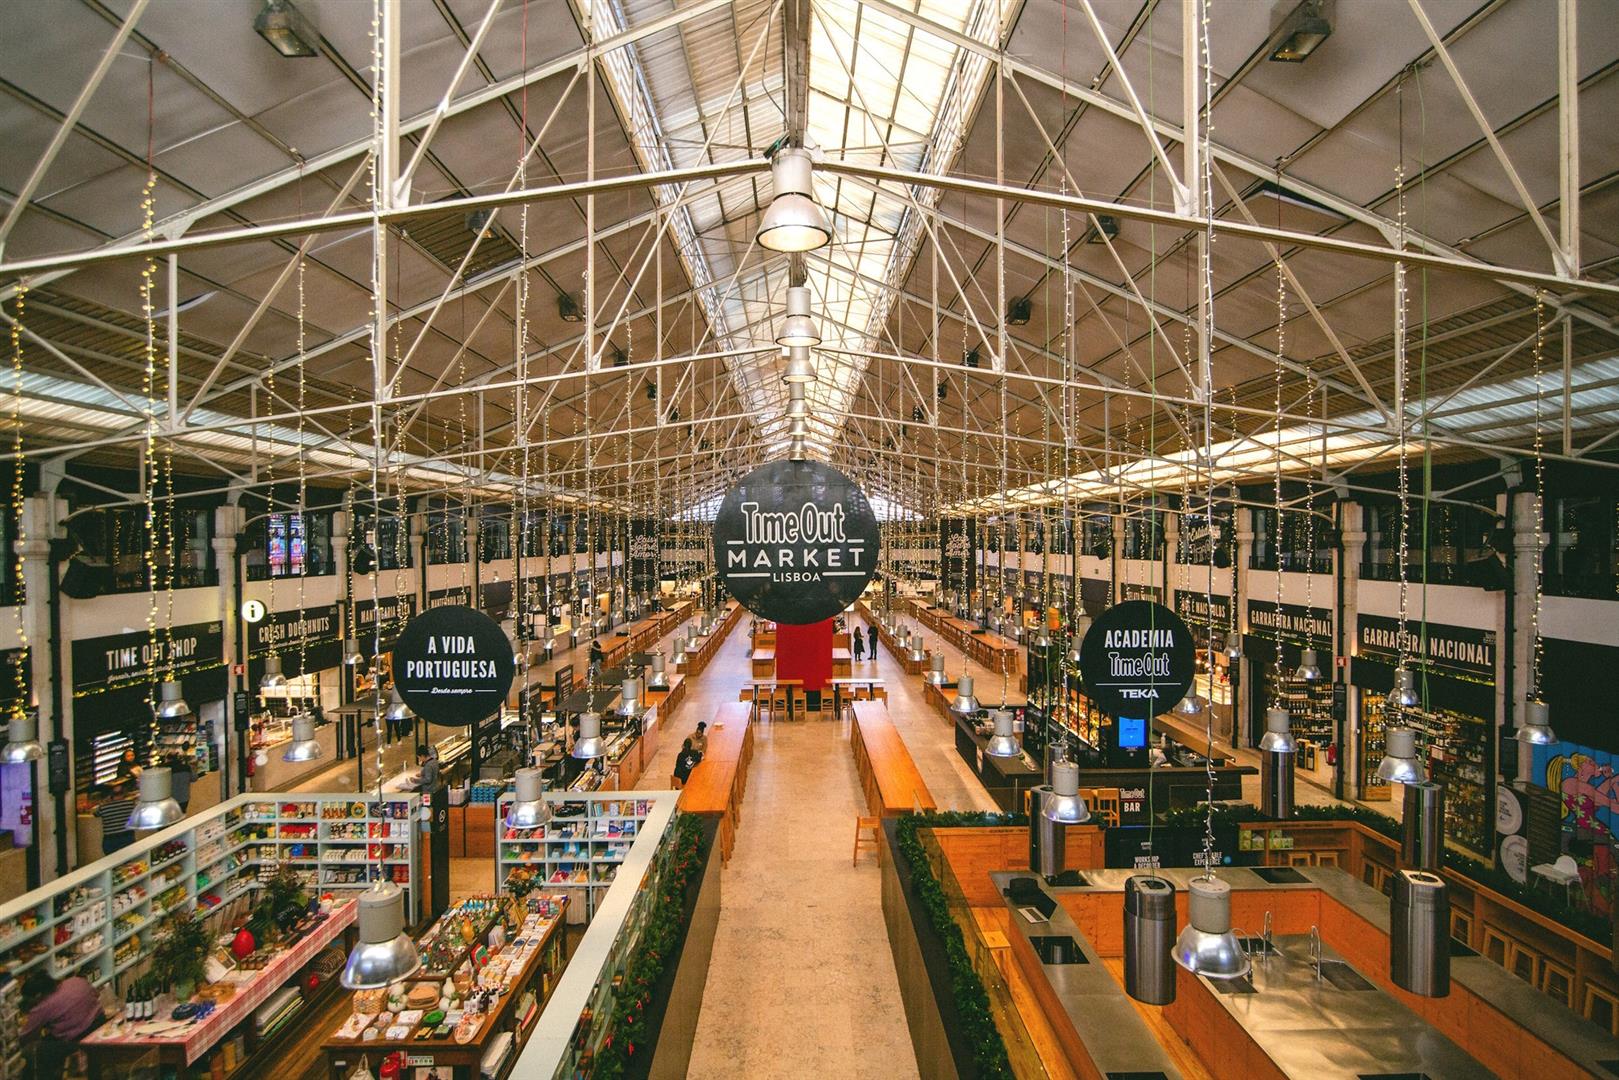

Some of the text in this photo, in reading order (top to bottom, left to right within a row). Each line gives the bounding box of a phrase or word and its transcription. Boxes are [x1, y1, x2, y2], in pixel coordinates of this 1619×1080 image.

[741, 502, 847, 544] Time Out
[727, 547, 865, 568] MARKET
[773, 572, 821, 582] LISBOA
[360, 605, 396, 624] MANTGARIA
[1293, 616, 1332, 637] NACONAL
[427, 636, 475, 654] A VIDA
[1104, 629, 1175, 648] ACADEMIA
[1363, 626, 1426, 654] GARRAFIRA
[1430, 637, 1492, 667] NACIONAL
[106, 646, 138, 671] TIME
[1108, 651, 1170, 677] Time Out
[407, 660, 497, 679] PORTUGUESA
[1119, 688, 1159, 699] TEKA
[1124, 802, 1141, 812] BAR
